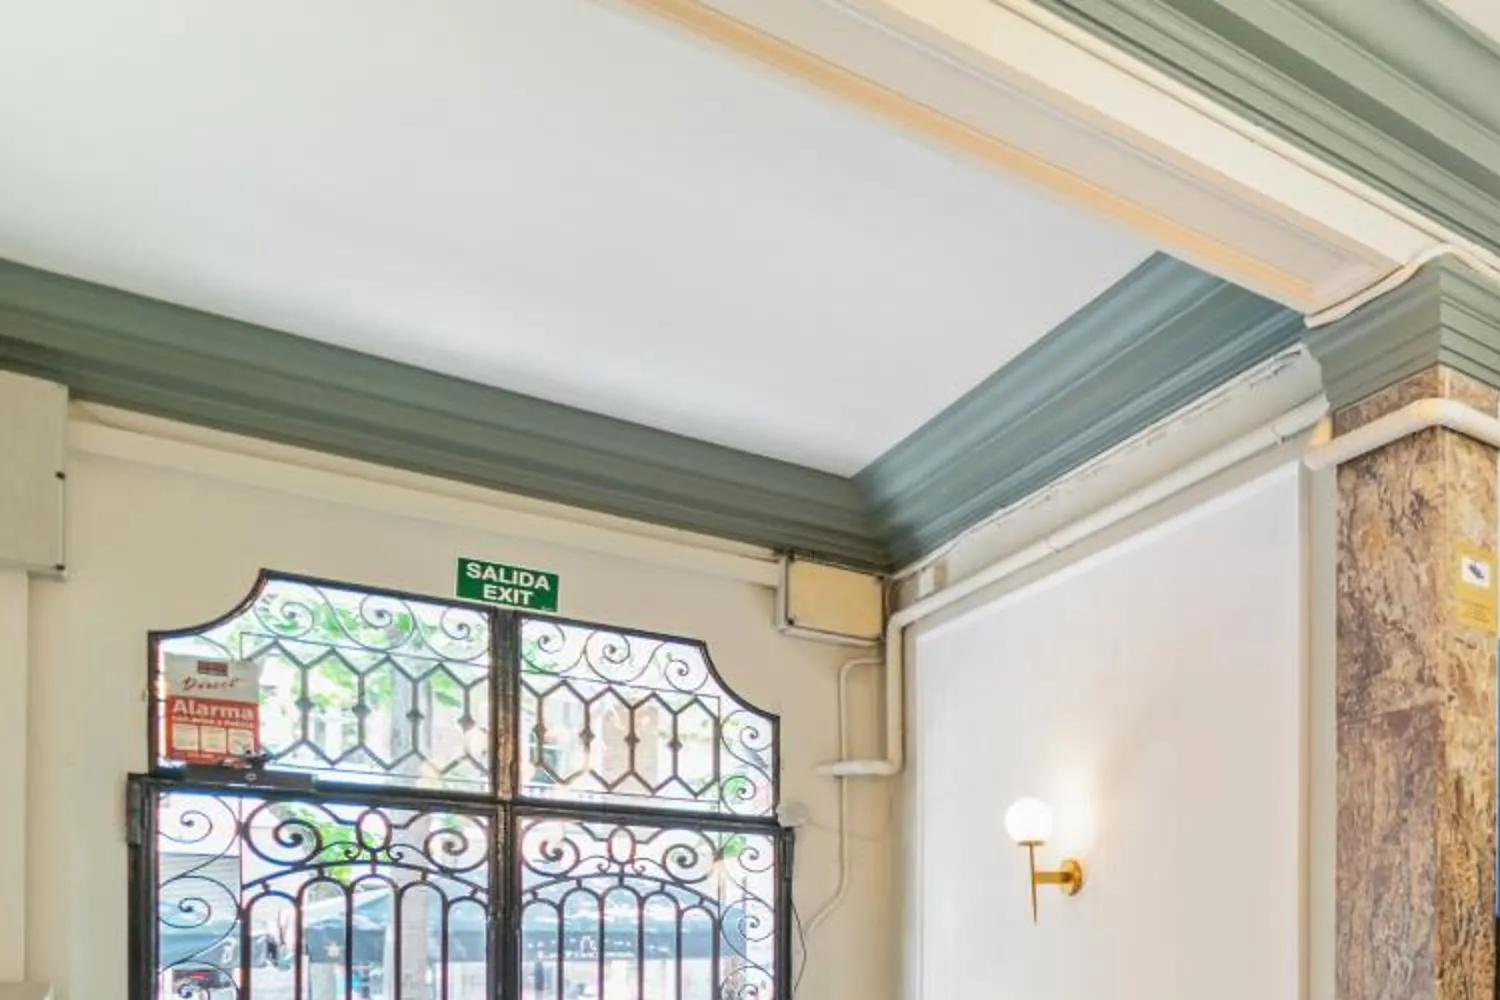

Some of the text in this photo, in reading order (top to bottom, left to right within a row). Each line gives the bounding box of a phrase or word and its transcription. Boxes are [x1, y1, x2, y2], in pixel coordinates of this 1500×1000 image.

[466, 562, 551, 591] SALIDA
[483, 584, 534, 605] EXIT
[172, 699, 255, 720] Alarma
